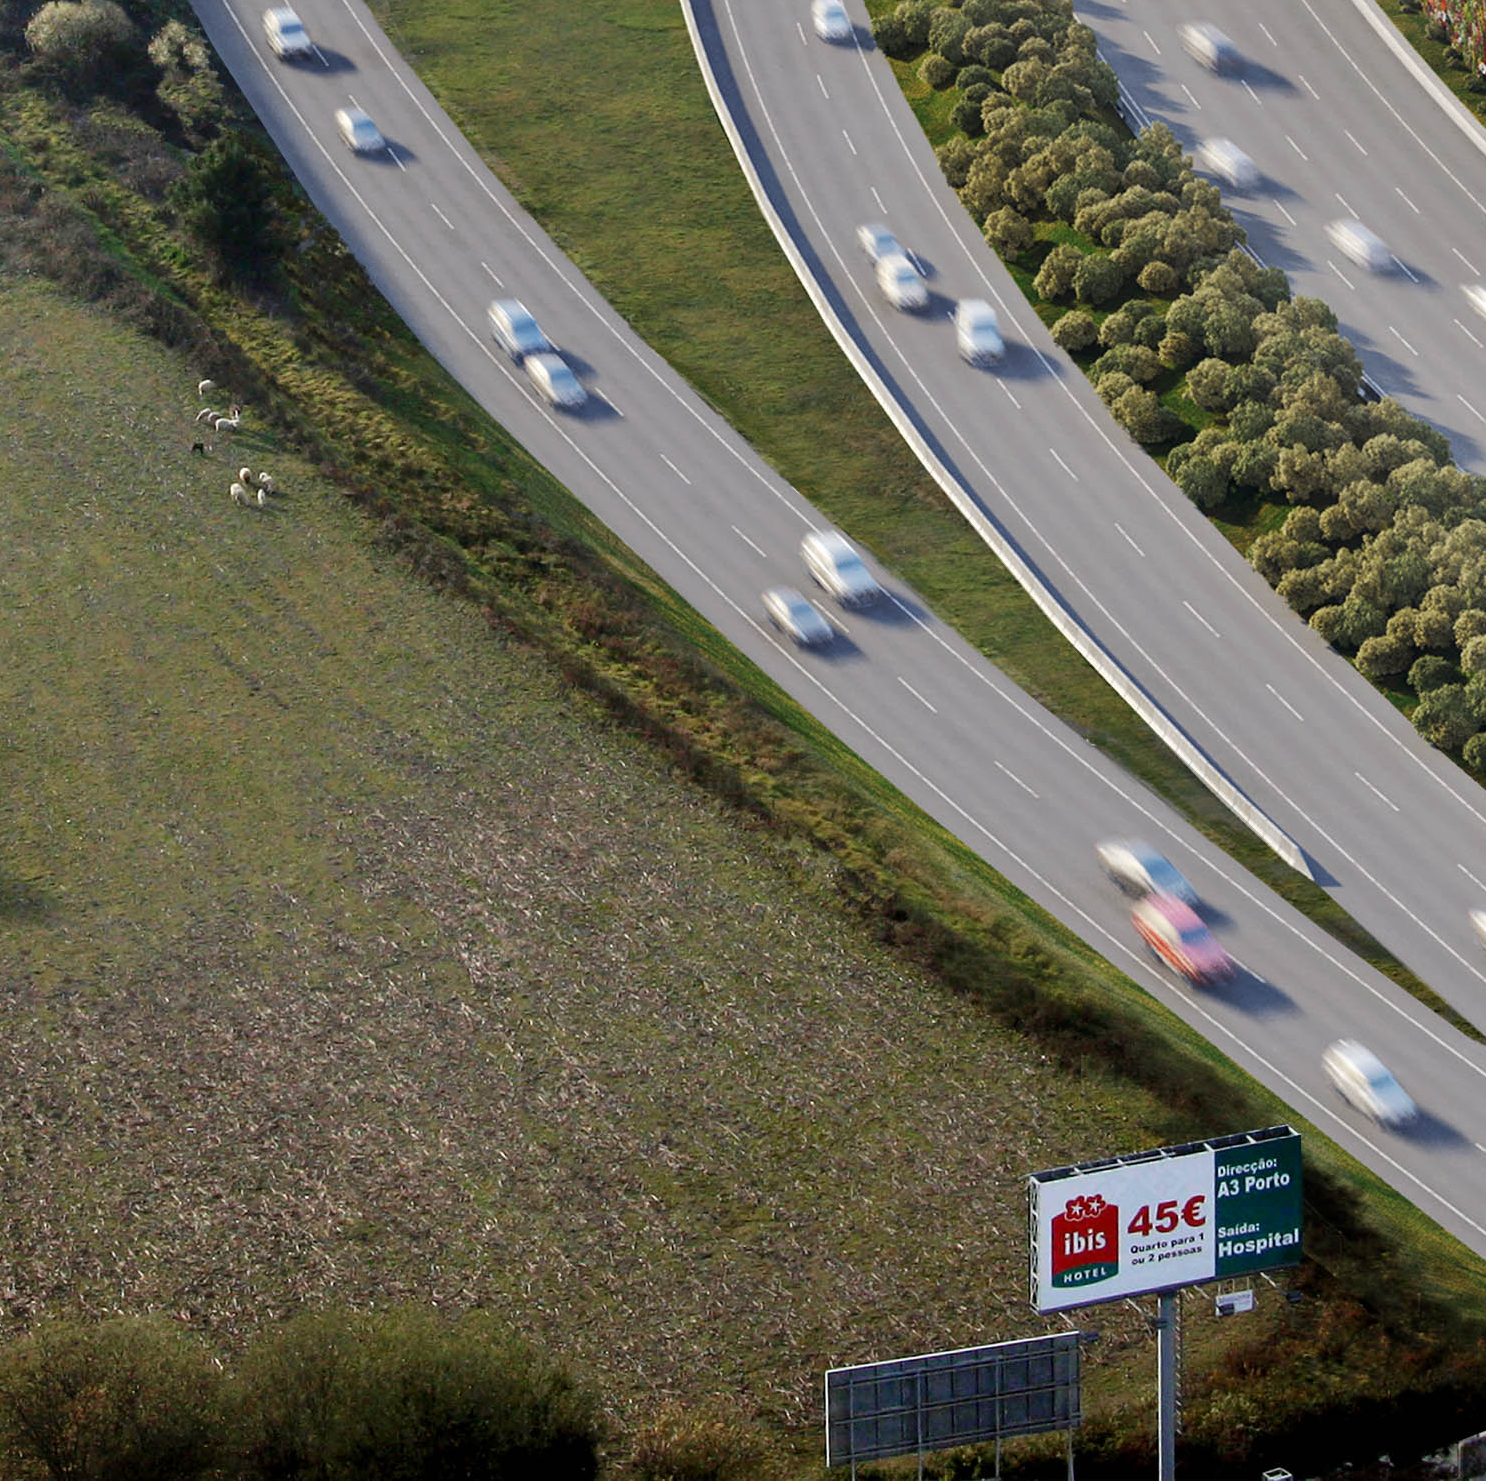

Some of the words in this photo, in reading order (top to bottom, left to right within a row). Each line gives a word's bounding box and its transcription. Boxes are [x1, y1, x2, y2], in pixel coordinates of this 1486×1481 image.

[1217, 1158, 1278, 1178] Direcção:
[1217, 1179, 1240, 1198] A3
[1245, 1171, 1290, 1193] Porto
[1127, 1194, 1207, 1237] 45€
[1217, 1223, 1260, 1238] Saída:
[1064, 1228, 1107, 1256] ibis
[1130, 1241, 1168, 1254] Quarto
[1171, 1236, 1195, 1248] para
[1199, 1232, 1204, 1240] 1
[1218, 1227, 1300, 1258] Hospital
[1131, 1257, 1145, 1265] ou
[1148, 1254, 1155, 1262] 2
[1158, 1246, 1202, 1262] pessoas
[1063, 1267, 1107, 1283] HOTEL
